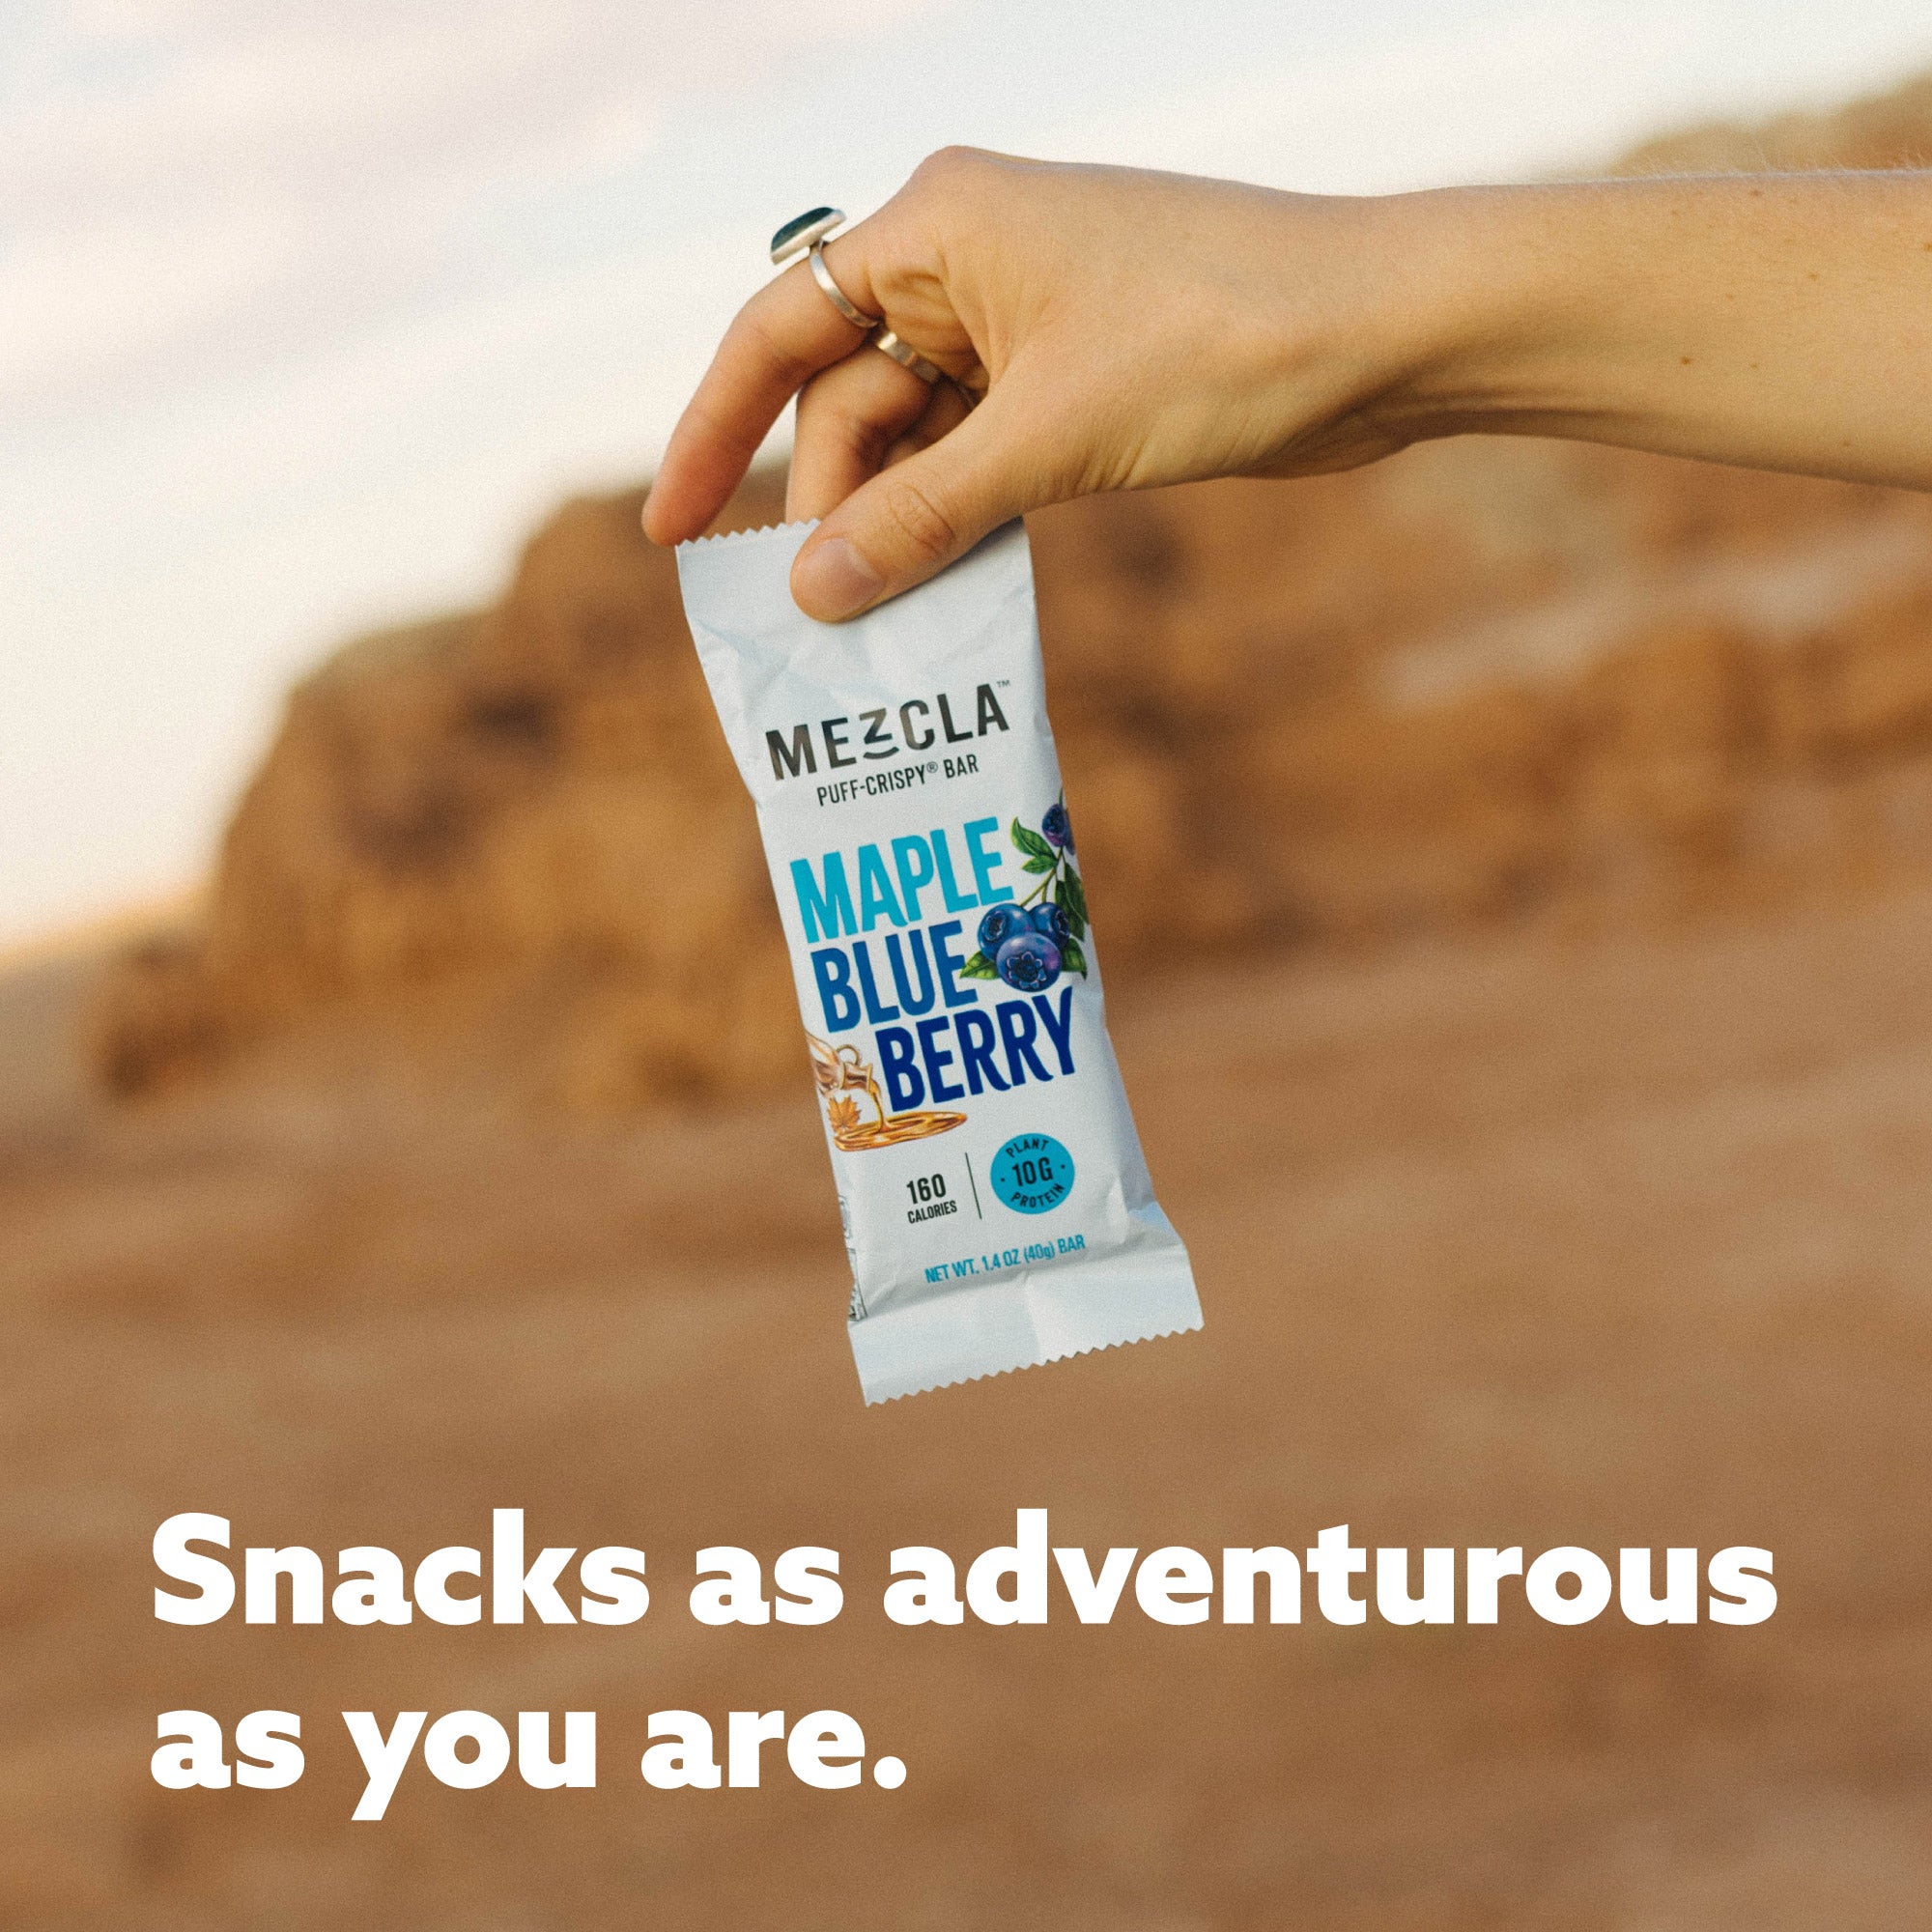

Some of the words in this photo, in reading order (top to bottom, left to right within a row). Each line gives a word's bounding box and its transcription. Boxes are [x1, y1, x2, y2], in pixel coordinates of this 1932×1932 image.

[943, 753, 980, 780] BAR
[789, 816, 1014, 944] MAPLE
[810, 920, 979, 1033] BLUE
[874, 985, 1076, 1113] BERRY
[1006, 1137, 1050, 1158] PLANT
[1011, 1156, 1054, 1187] 10G
[906, 1173, 947, 1205] 160
[1010, 1182, 1065, 1208] PROTEIN
[907, 1200, 957, 1225] CALORIES
[924, 1264, 951, 1284] NET
[952, 1259, 980, 1278] WT.
[981, 1253, 1001, 1272] 1.4
[1003, 1248, 1021, 1267] OZ
[1023, 1241, 1056, 1264] (40g)
[1057, 1234, 1086, 1254] BAR
